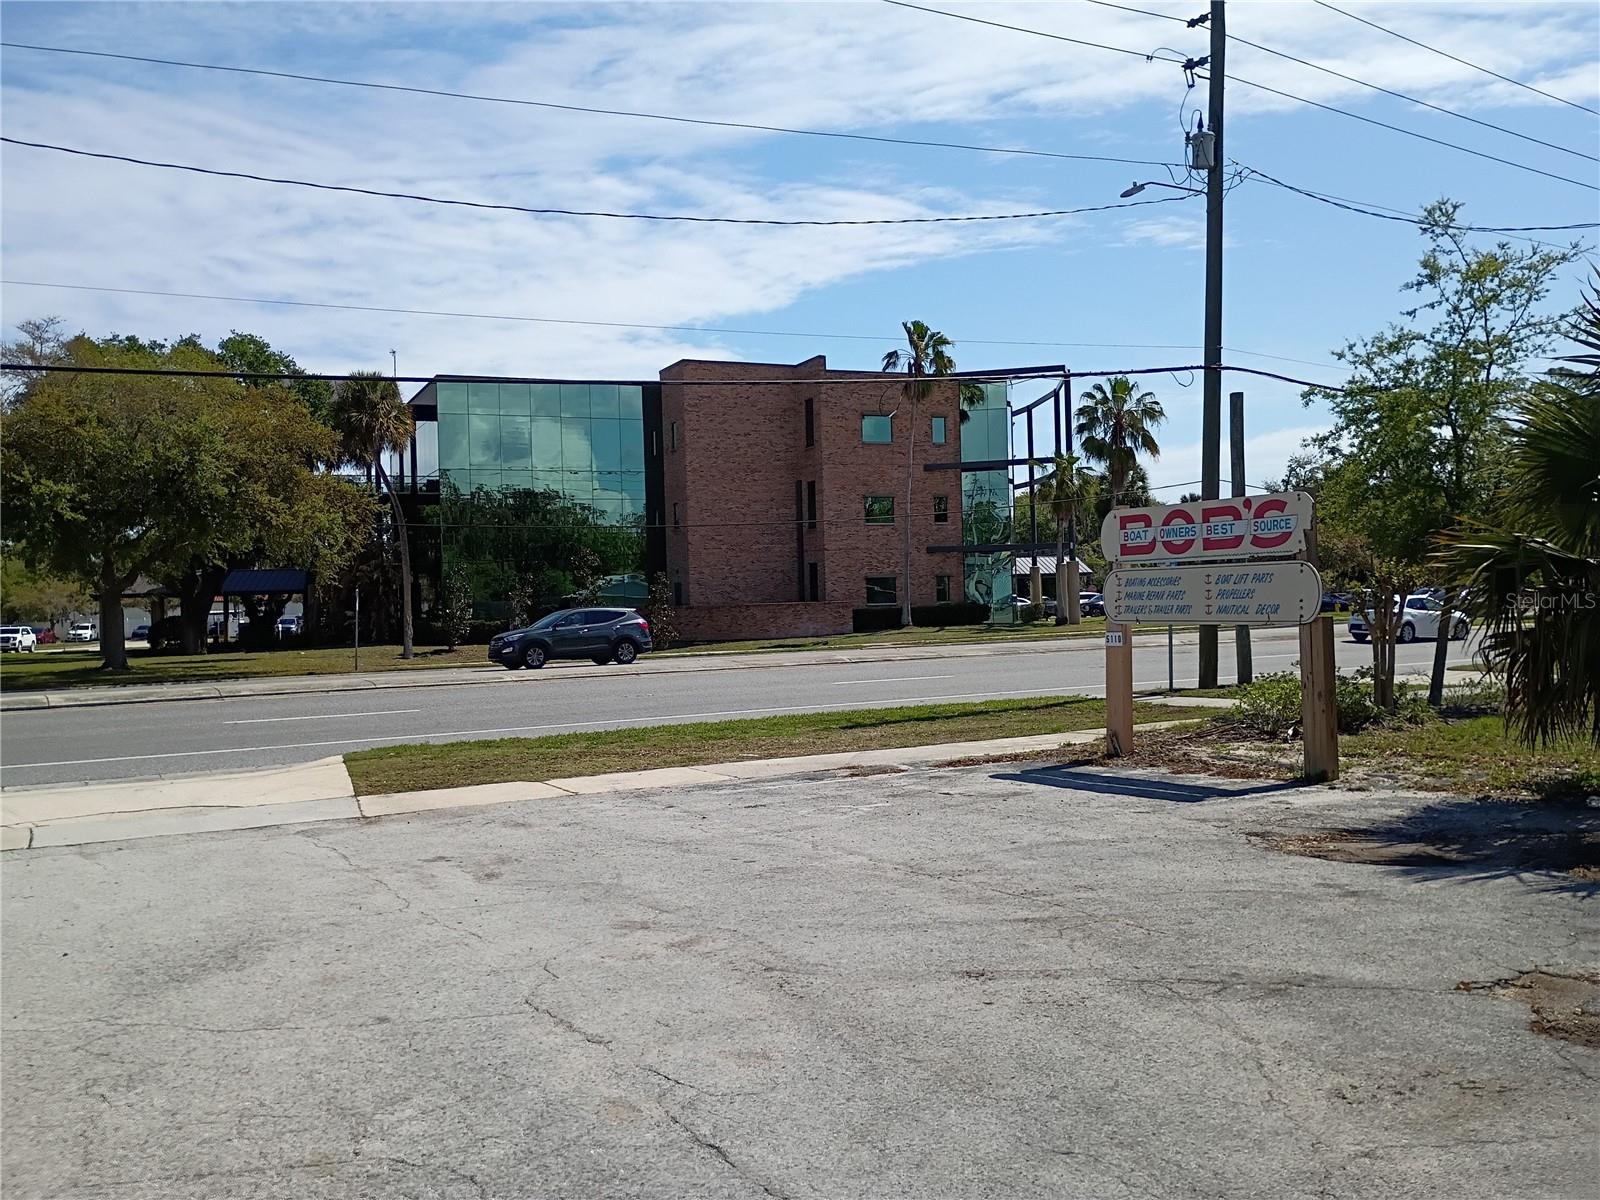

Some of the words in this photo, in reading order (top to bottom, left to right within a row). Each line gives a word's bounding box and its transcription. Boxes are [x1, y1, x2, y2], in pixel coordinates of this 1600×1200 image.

[1123, 529, 1149, 542] BOAT
[1159, 525, 1197, 540] OWNERS
[1206, 522, 1236, 536] BEST
[1252, 517, 1292, 532] SOURCE
[1124, 577, 1147, 588] BOATING
[1146, 576, 1182, 587] ACCESSORIES
[1215, 574, 1233, 585] BOAT
[1233, 573, 1249, 585] LIFT
[1250, 572, 1274, 584] PARTS
[1123, 591, 1145, 601] MARINE
[1145, 590, 1165, 601] REPAIR
[1165, 590, 1186, 601] PARTS
[1215, 588, 1256, 600] PROPELLERS
[1123, 605, 1148, 615] TRAILERS
[1152, 605, 1174, 615] TRAILER
[1174, 604, 1193, 615] PARTS
[1215, 604, 1249, 615] NAUTICAL
[1255, 603, 1281, 615] DECOR
